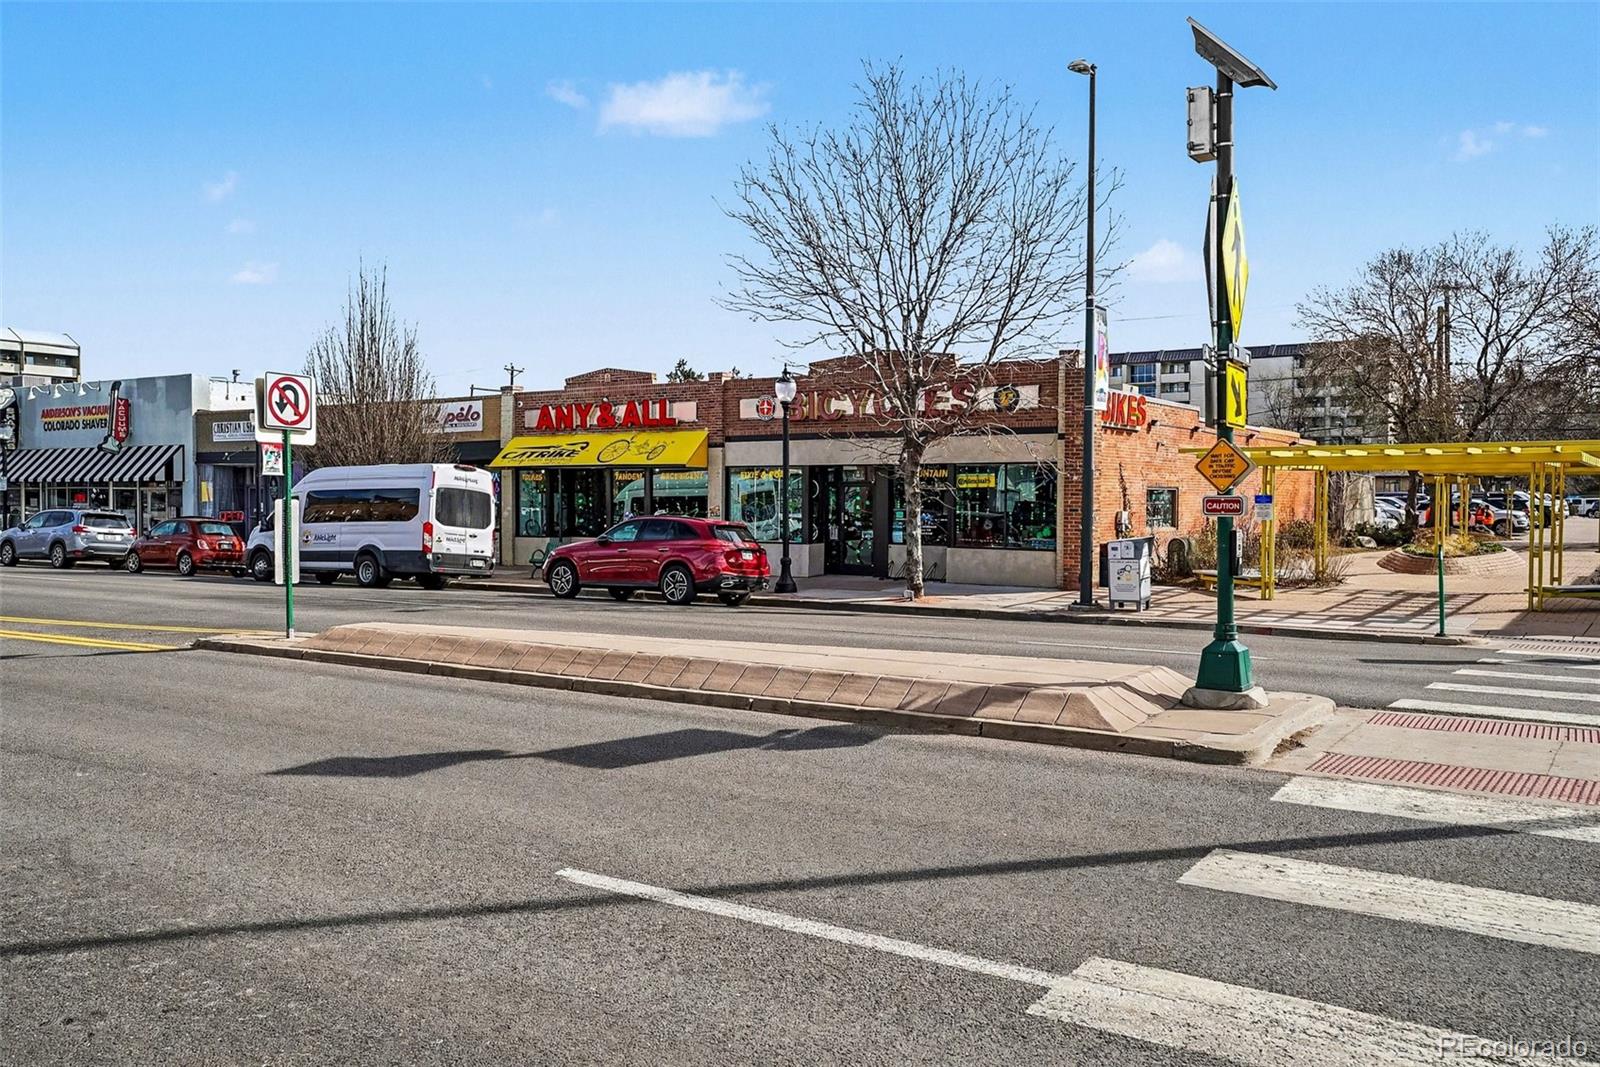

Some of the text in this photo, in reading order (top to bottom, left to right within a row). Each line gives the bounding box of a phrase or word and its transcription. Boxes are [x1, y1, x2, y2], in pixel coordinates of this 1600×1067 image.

[789, 382, 975, 421] BICYCES
[41, 407, 82, 419] ANDERSON'S
[117, 400, 127, 437] VACUUMS
[536, 399, 677, 430] ANY & ALL
[43, 420, 80, 431] COLORADO
[214, 422, 241, 433] CHRISTIAN
[501, 449, 579, 459] CATRIKE
[1207, 502, 1240, 510] CAUTION
